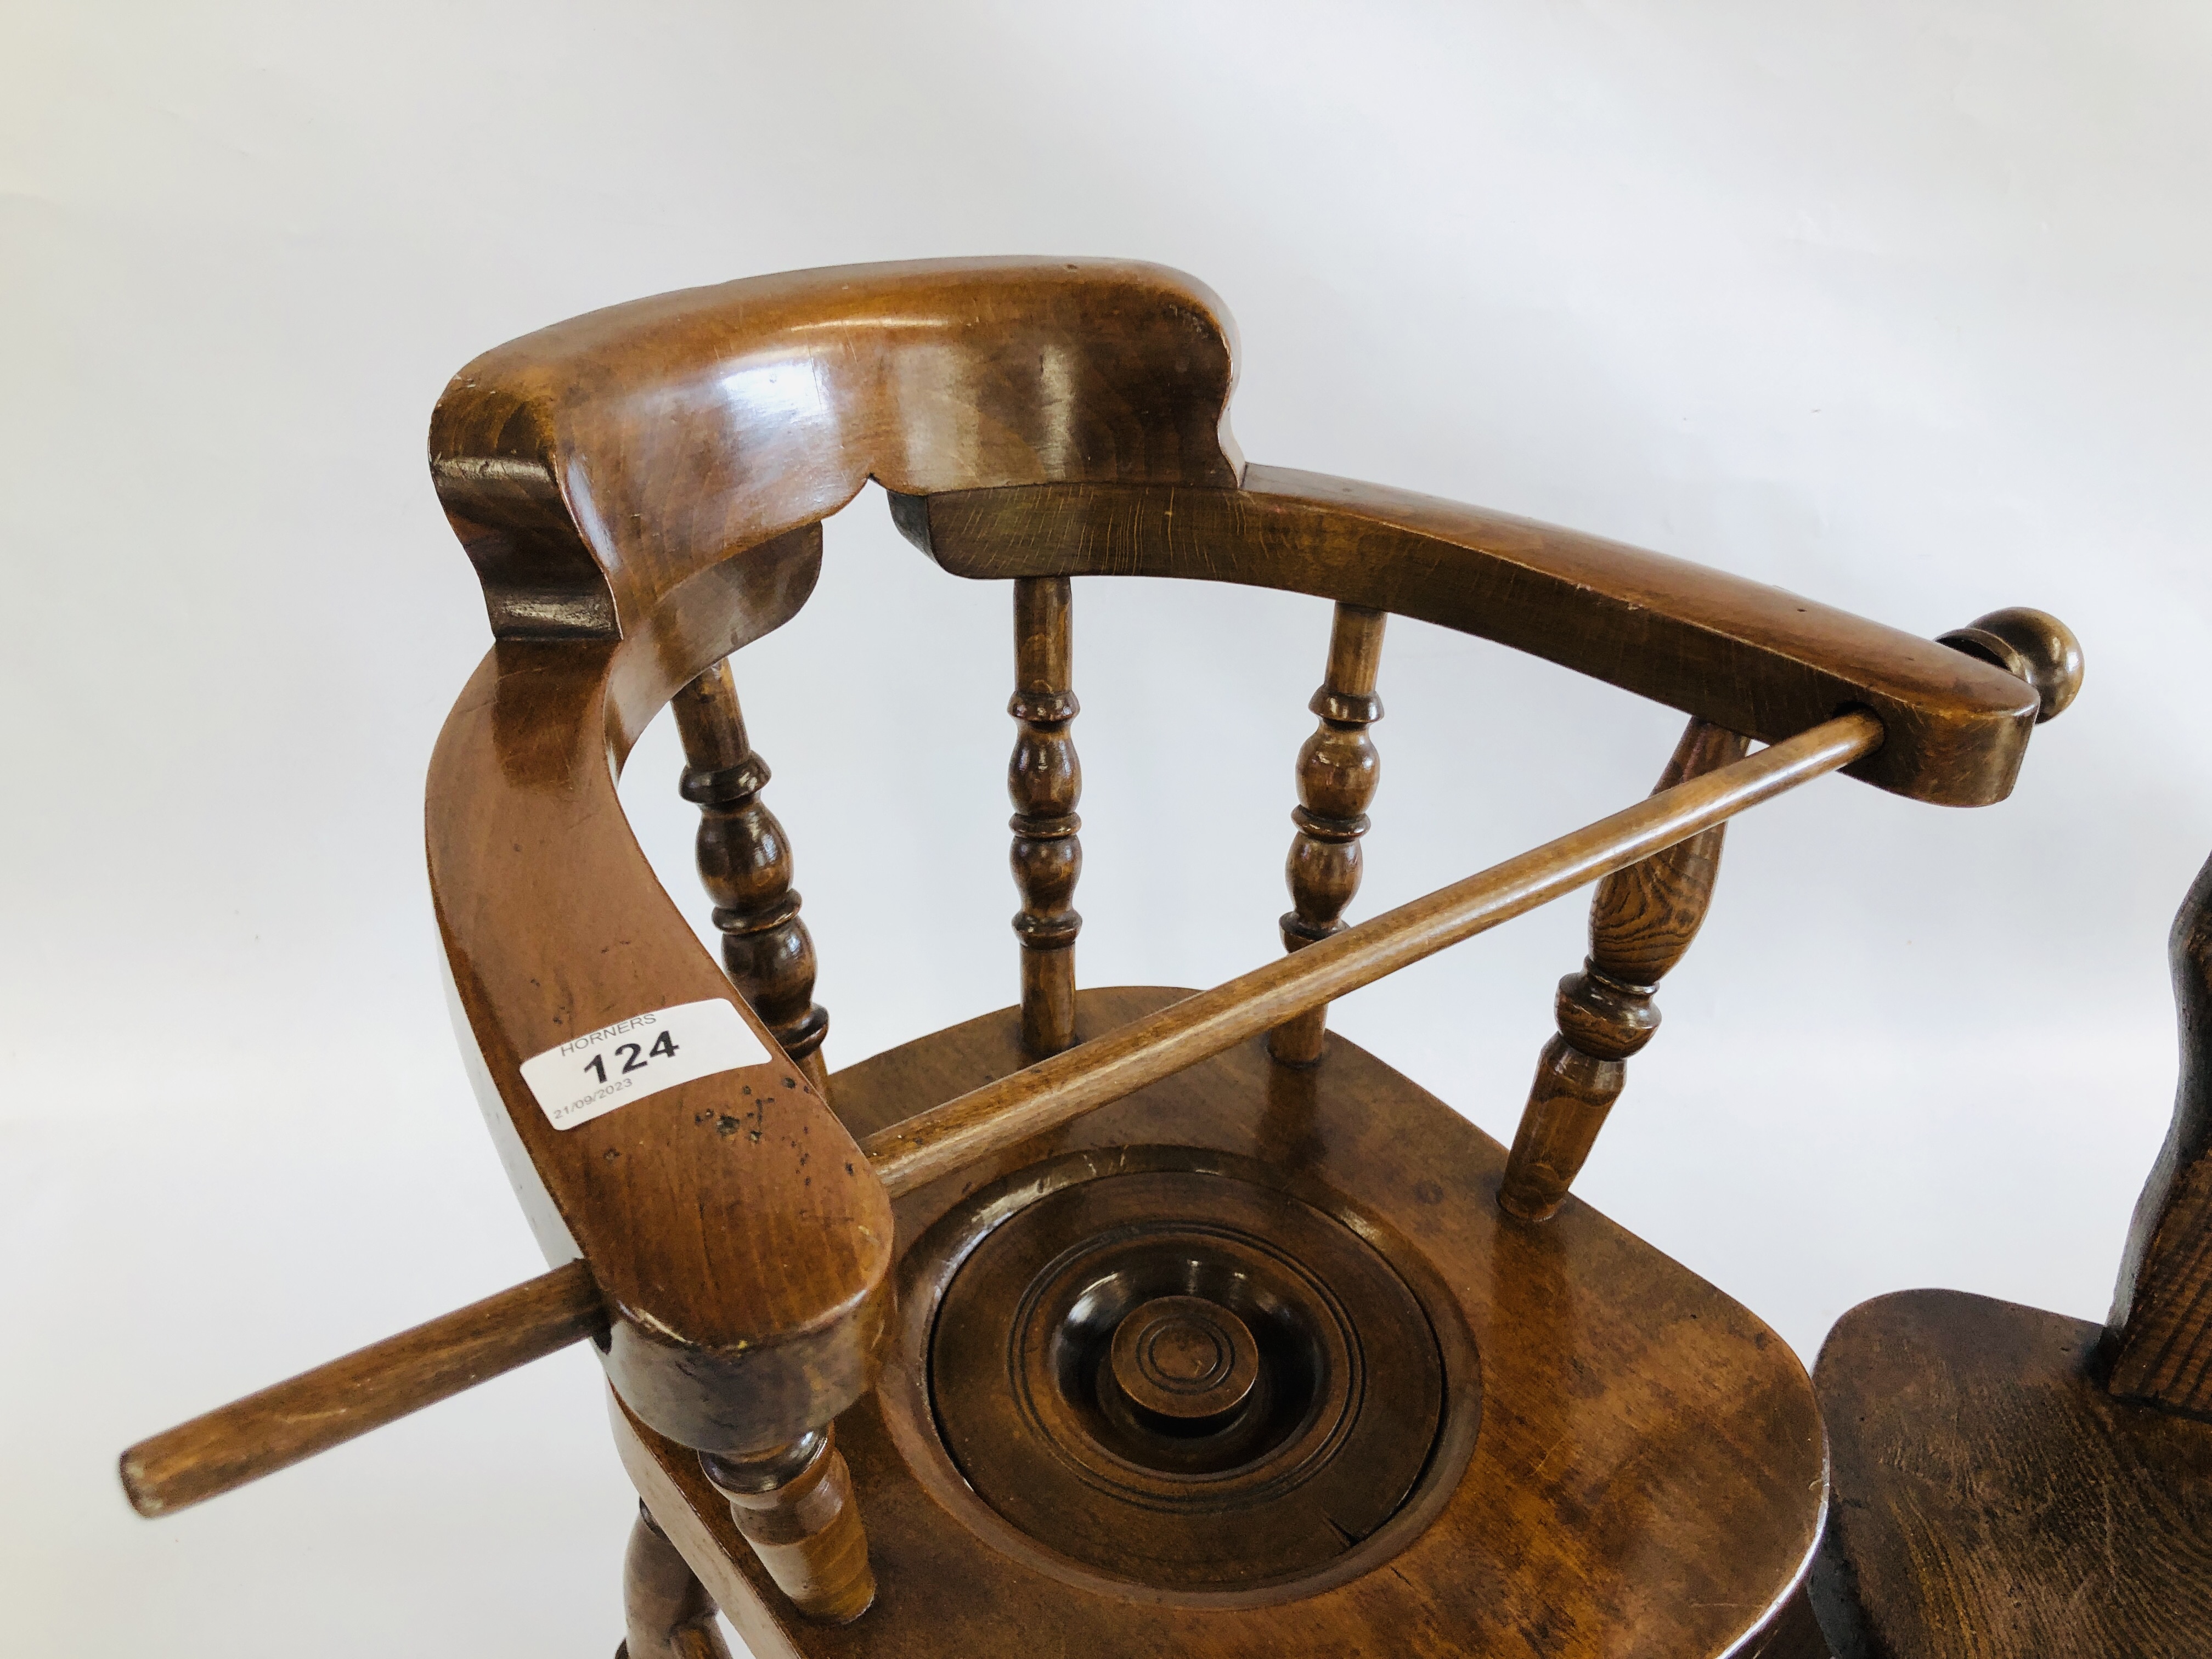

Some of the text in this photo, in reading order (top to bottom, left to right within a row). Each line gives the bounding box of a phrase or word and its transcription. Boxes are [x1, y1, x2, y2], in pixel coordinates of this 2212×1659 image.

[561, 1013, 657, 1057] HORNERS
[584, 1030, 680, 1084] 124
[553, 1078, 633, 1119] 21/09/2023
